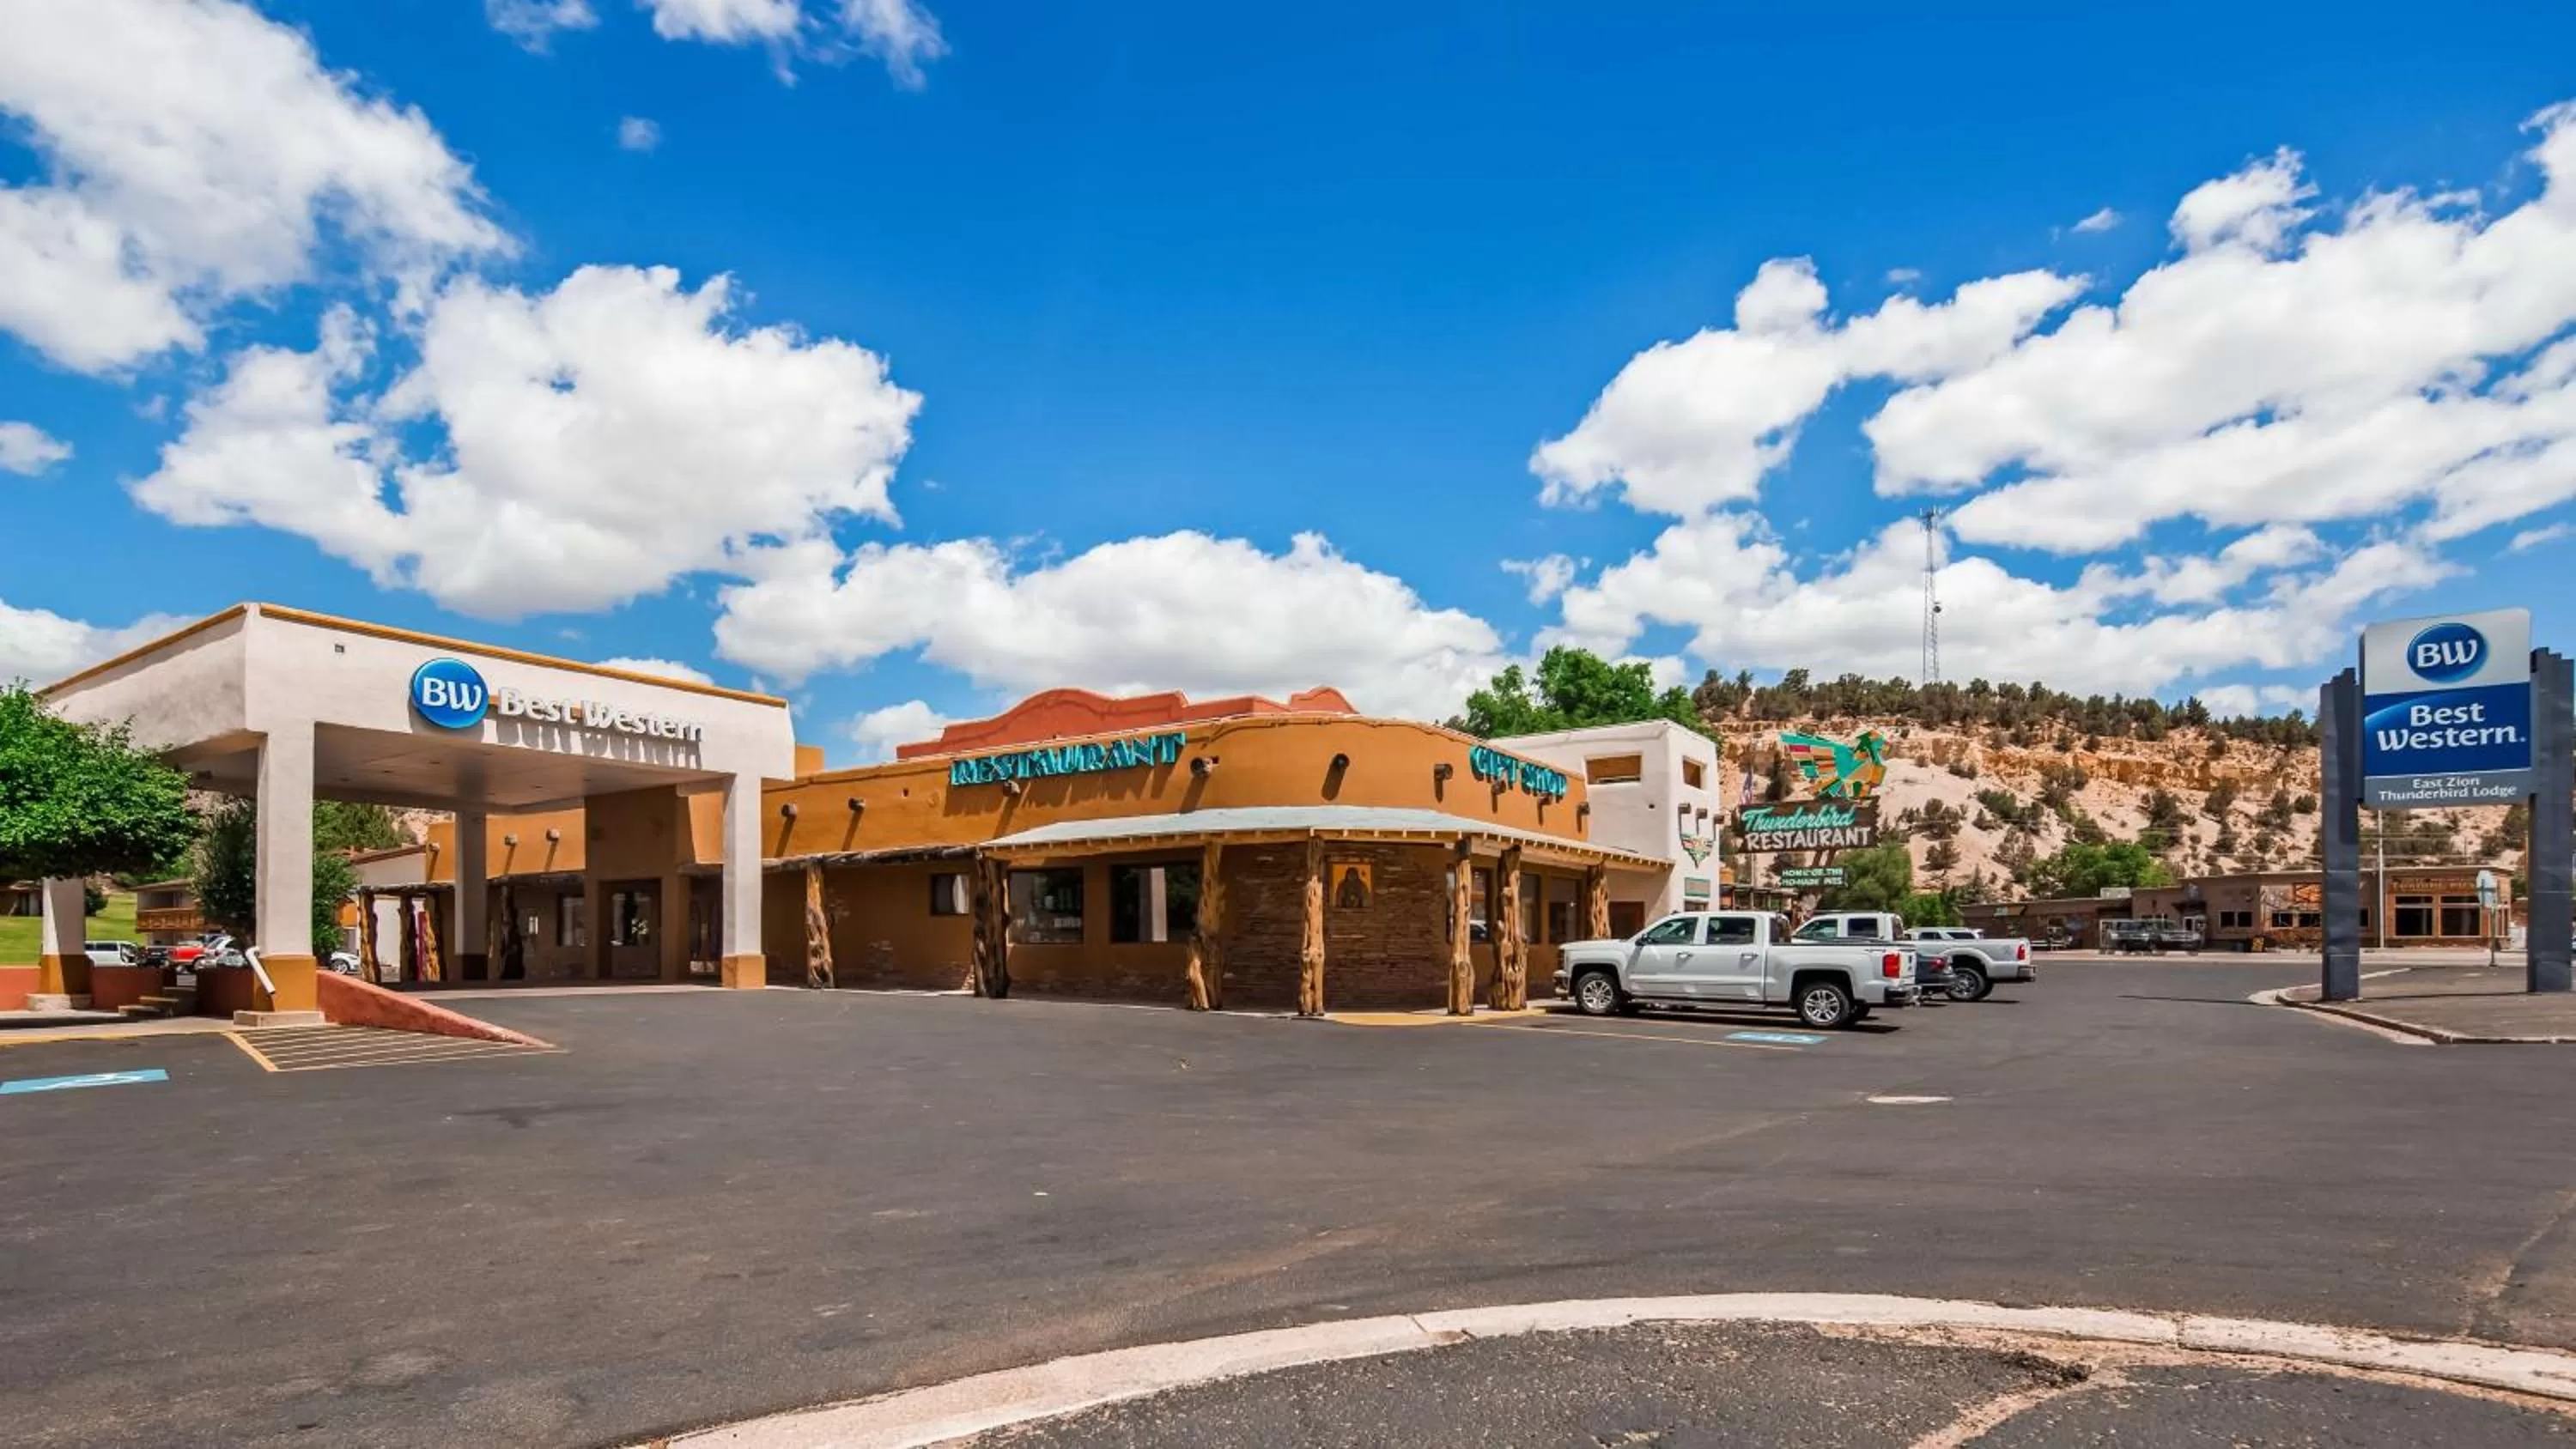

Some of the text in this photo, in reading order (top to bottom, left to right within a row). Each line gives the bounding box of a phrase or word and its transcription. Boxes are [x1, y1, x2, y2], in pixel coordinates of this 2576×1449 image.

[2417, 639, 2478, 668] BW
[422, 677, 482, 712] BW
[499, 688, 704, 741] Best Western
[2410, 702, 2485, 726] Best
[951, 731, 1186, 785] RESTAURANT
[1469, 746, 1567, 797] GIFT SHOP
[2379, 785, 2518, 802] Thunderbird Lodge
[2413, 777, 2480, 789] East Zion
[1741, 804, 1856, 831] Thunderbird
[1746, 827, 1870, 851] RESTAURANT
